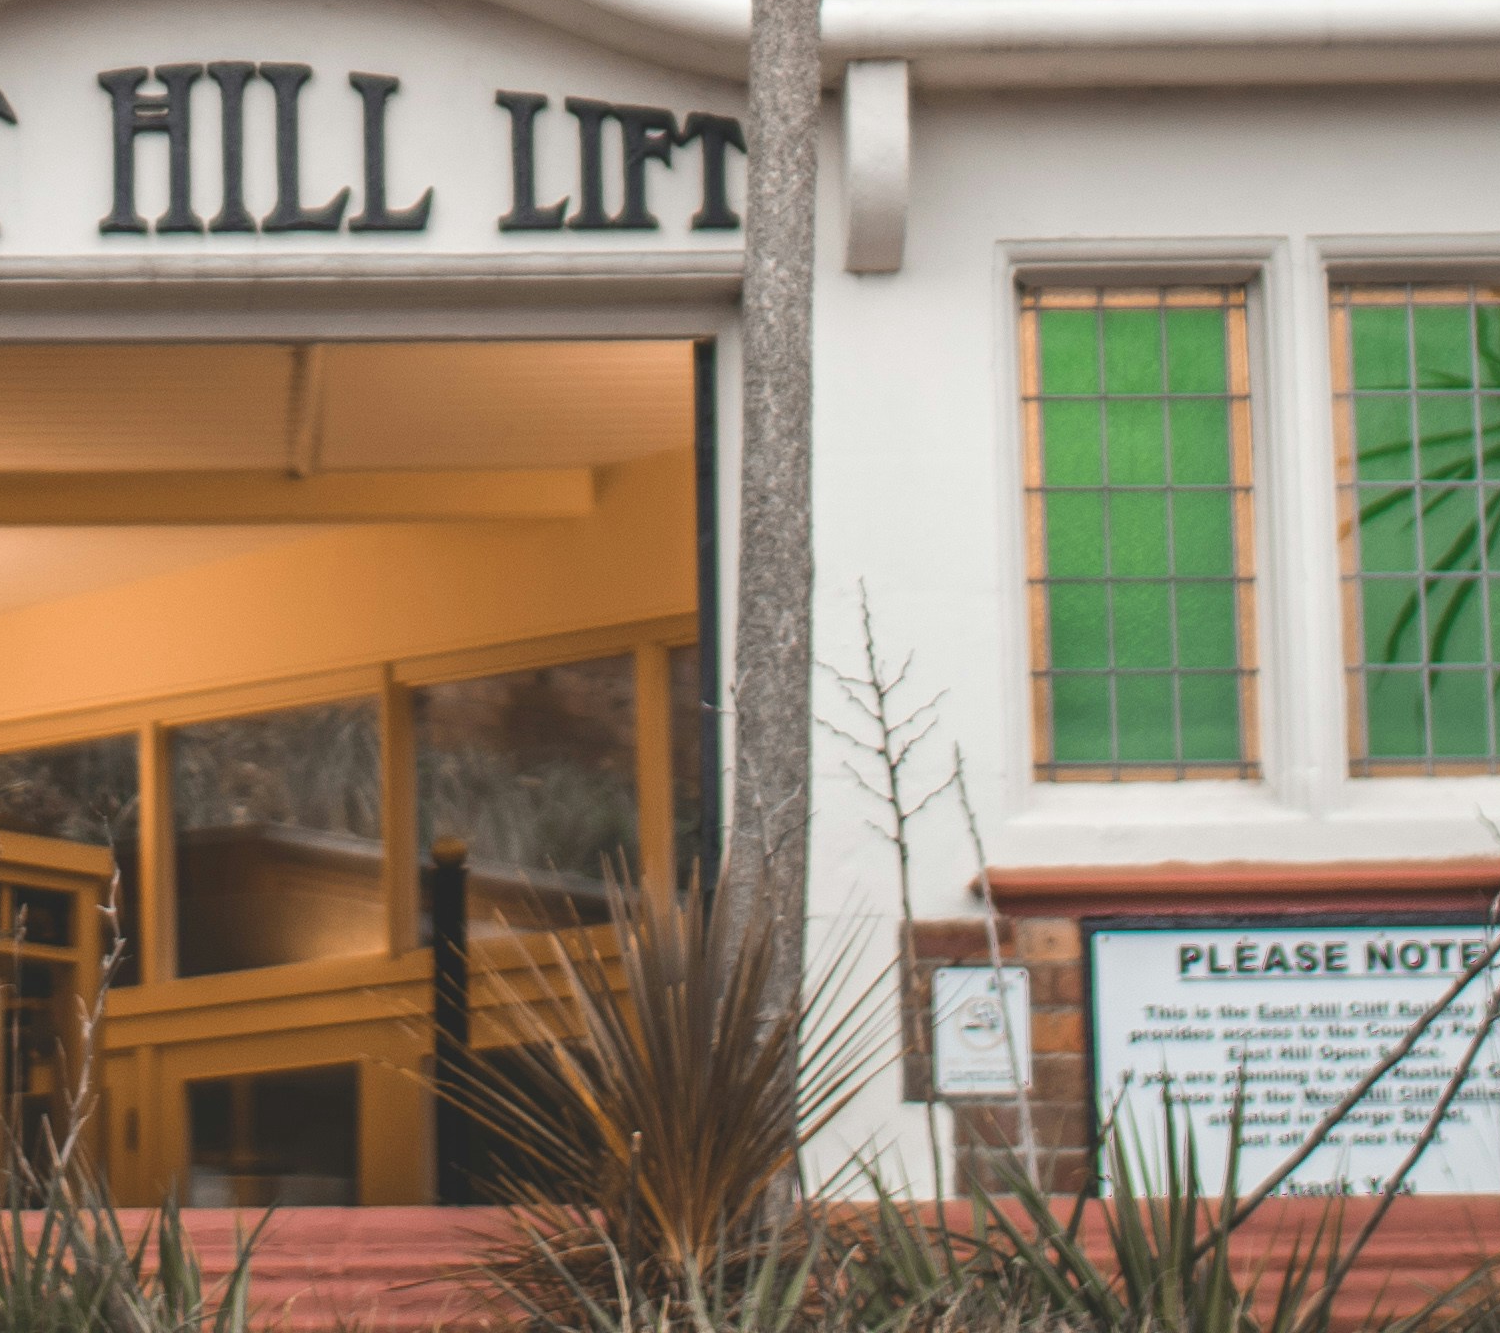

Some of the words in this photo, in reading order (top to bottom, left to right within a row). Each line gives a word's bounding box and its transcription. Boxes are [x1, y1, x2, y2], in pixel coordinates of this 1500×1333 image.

[98, 60, 434, 234] HILL
[496, 89, 748, 231] LIFT
[1178, 941, 1349, 974] PLEASE
[1363, 938, 1485, 971] NOTE
[1145, 1004, 1187, 1019] This
[1194, 1004, 1211, 1019] is
[1219, 1003, 1250, 1018] the
[1257, 1002, 1301, 1018] East
[1309, 1001, 1341, 1017] Hill
[1349, 1000, 1389, 1017] Cliff
[1129, 1025, 1214, 1044] provides
[1300, 1025, 1320, 1039] to
[1327, 1023, 1357, 1038] the
[1279, 1044, 1312, 1060] Hill
[1319, 1044, 1370, 1061] Open
[1316, 1067, 1337, 1080] to
[1263, 1088, 1296, 1102] the
